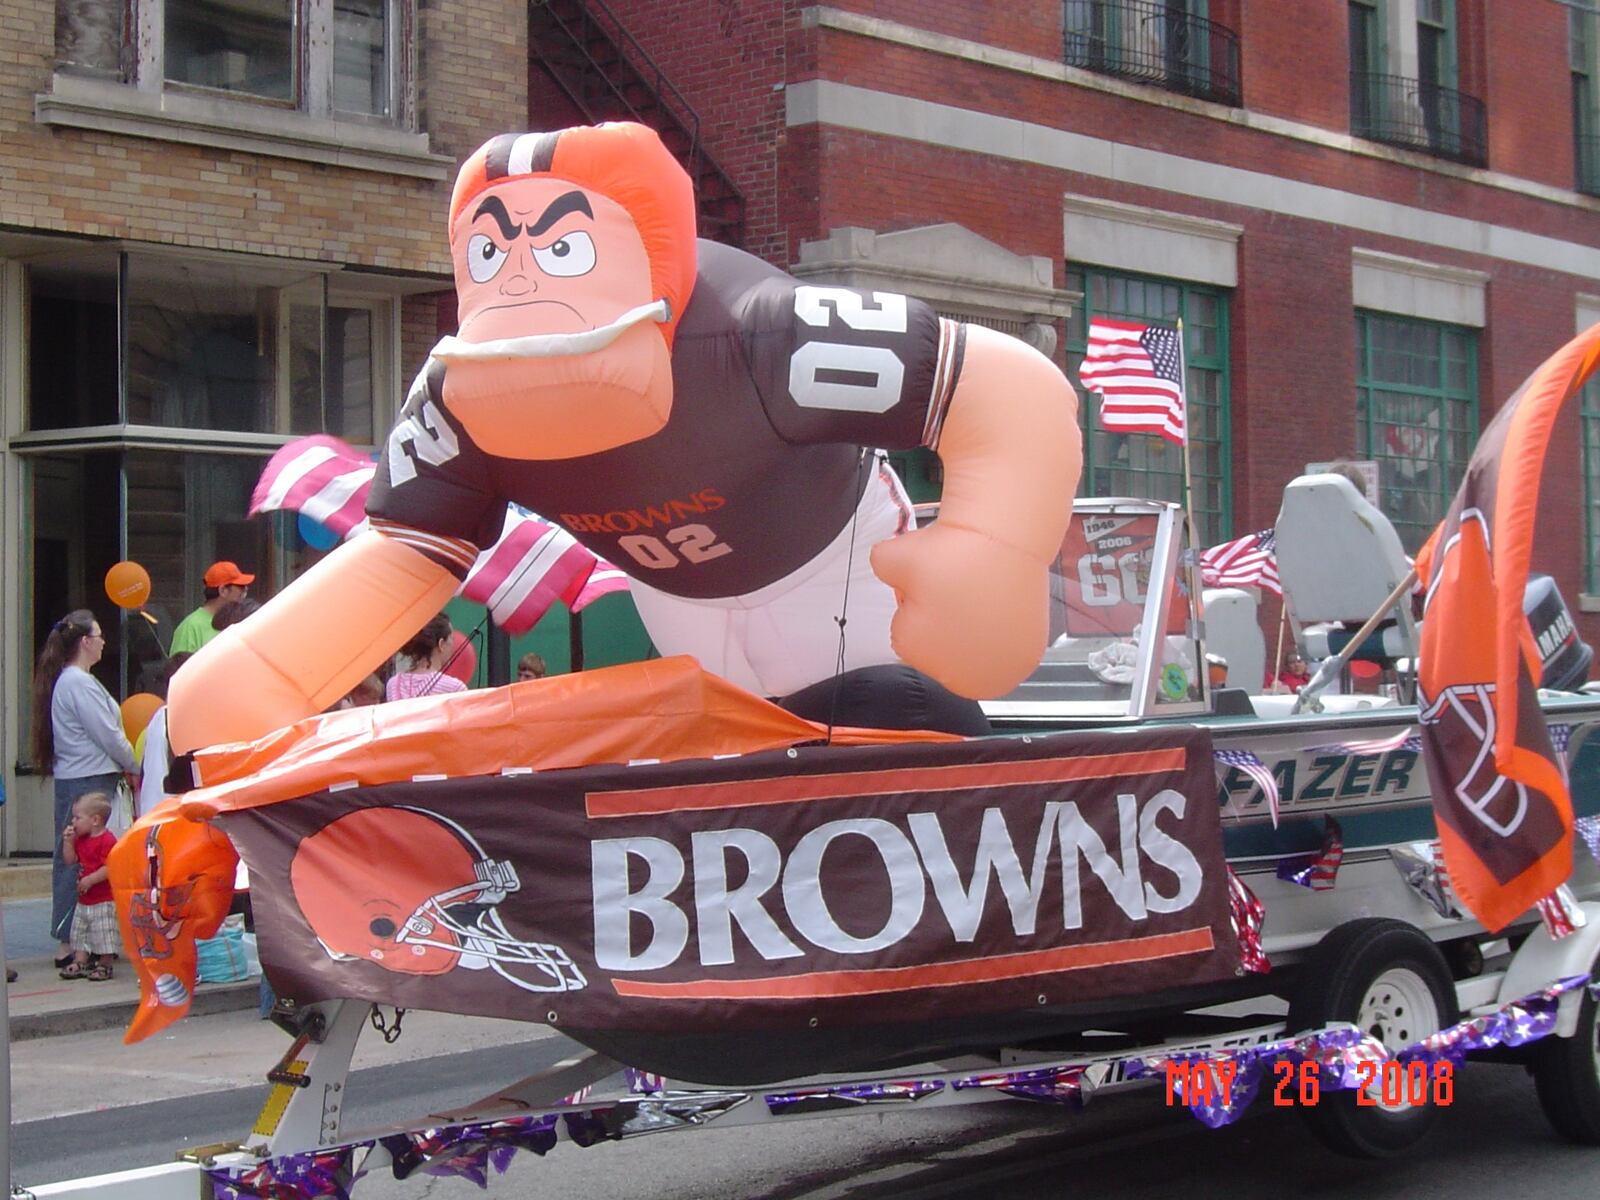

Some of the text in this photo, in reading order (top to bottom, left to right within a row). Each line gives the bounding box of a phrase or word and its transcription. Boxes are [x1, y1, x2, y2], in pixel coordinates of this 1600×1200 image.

[560, 488, 727, 533] BROWNS
[617, 523, 733, 569] 02
[1097, 535, 1132, 549] 2006
[591, 789, 1204, 971] BROWNS
